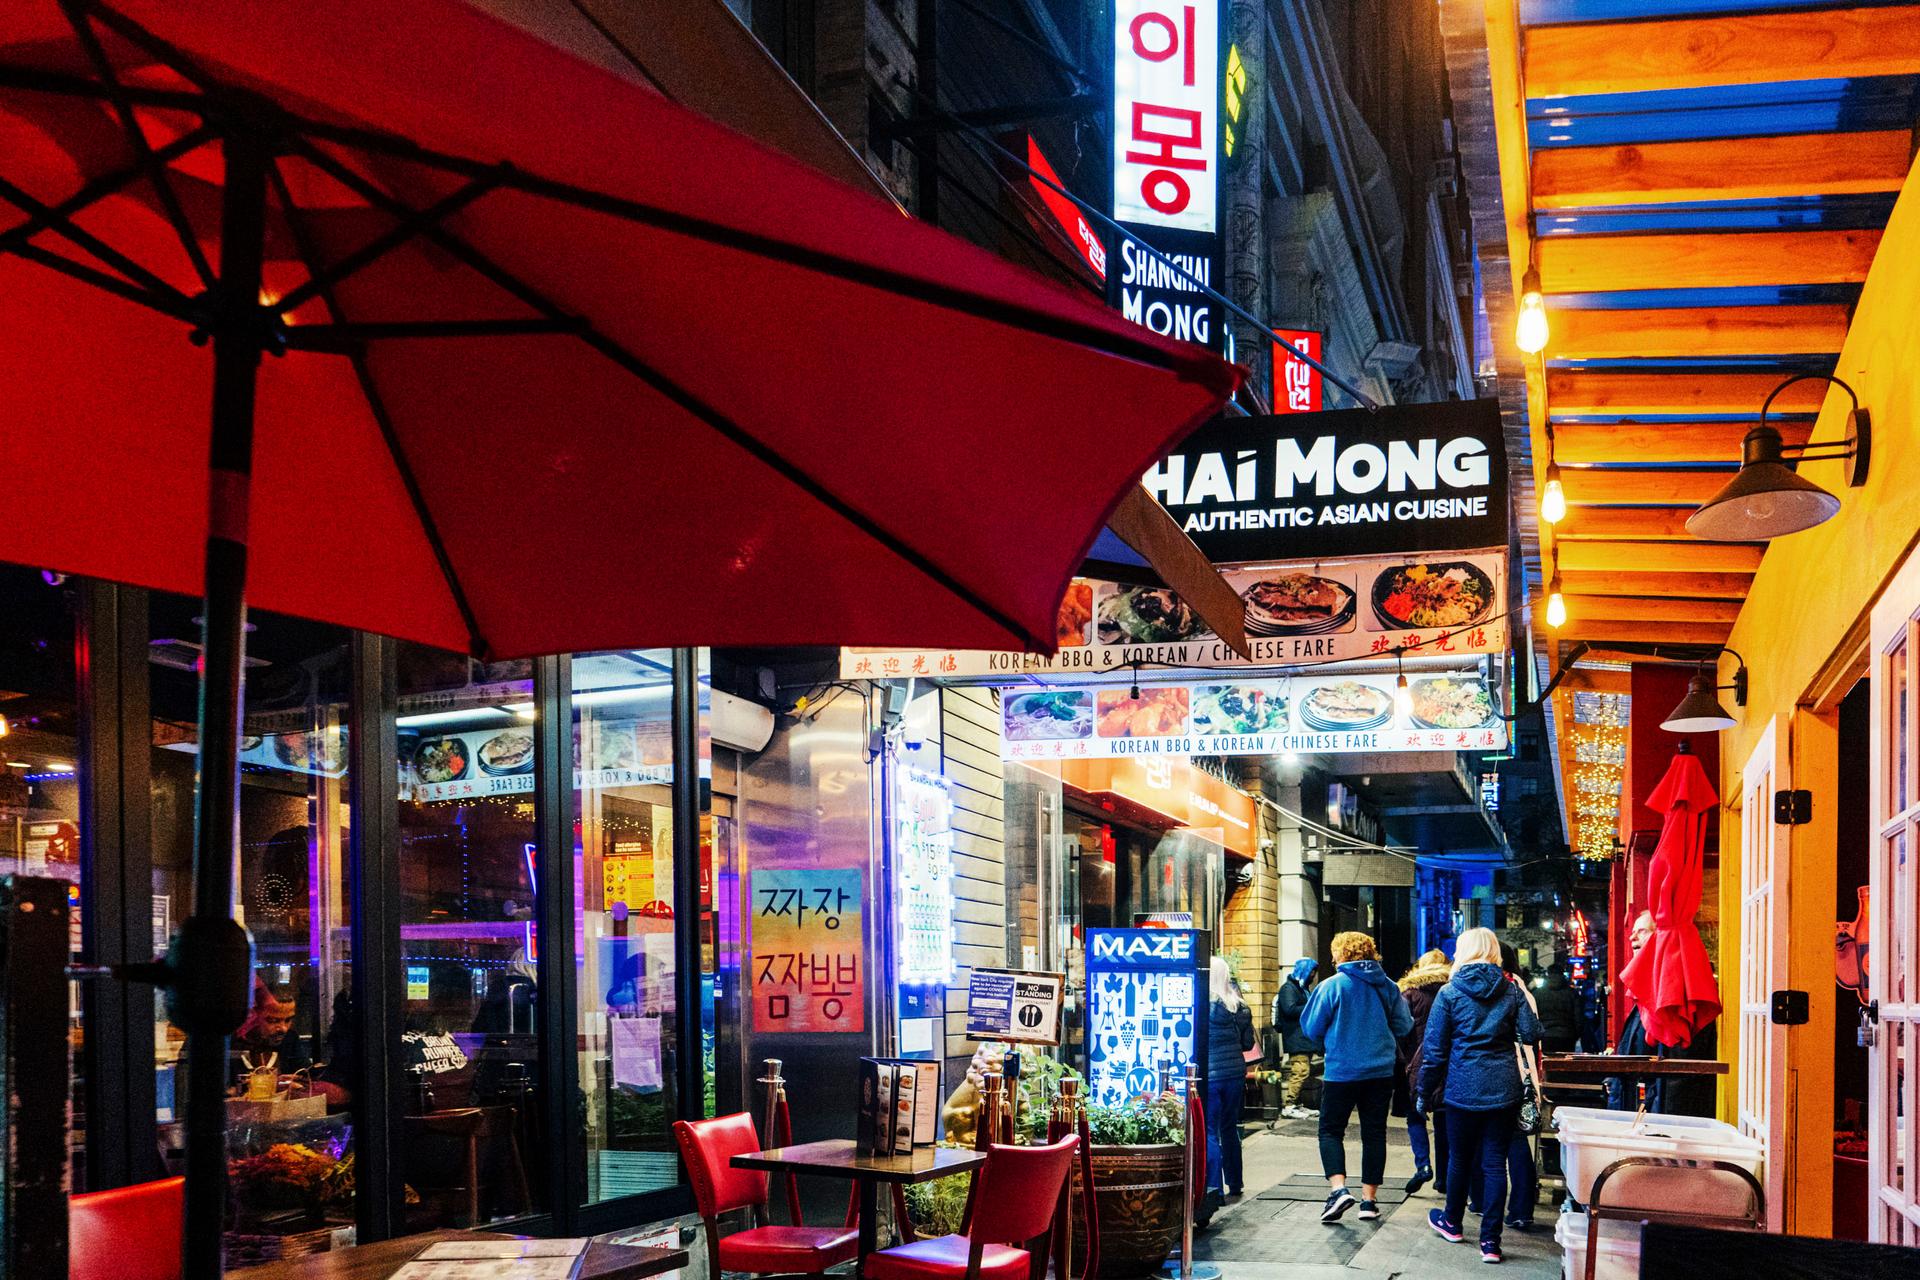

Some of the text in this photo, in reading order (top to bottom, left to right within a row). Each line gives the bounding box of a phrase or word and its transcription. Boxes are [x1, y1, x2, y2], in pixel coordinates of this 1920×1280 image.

[1126, 5, 1207, 215] 이몽
[1122, 239, 1209, 292] SHANGHAI
[1123, 288, 1208, 343] MONG
[1275, 436, 1490, 498] MONG
[1184, 497, 1488, 533] AUTHENTIC ASIAN CUISINE
[855, 655, 958, 675] 欢迎光临
[1062, 649, 1094, 667] BBQ
[1103, 650, 1113, 666] &
[1123, 641, 1188, 665] KOREAN
[1294, 637, 1335, 658] FARE
[1111, 739, 1160, 754] KOREAN
[1166, 738, 1191, 752] BBQ
[1198, 739, 1206, 752] &
[1213, 736, 1263, 751] KOREAN
[1283, 734, 1338, 749] CHINESE
[1346, 733, 1378, 748] FARE
[759, 886, 851, 930] 짜장
[1093, 934, 1190, 956] MAZE
[755, 952, 857, 1021] 짬뽕
[1015, 990, 1052, 999] STANDING
[1028, 984, 1039, 992] NO
